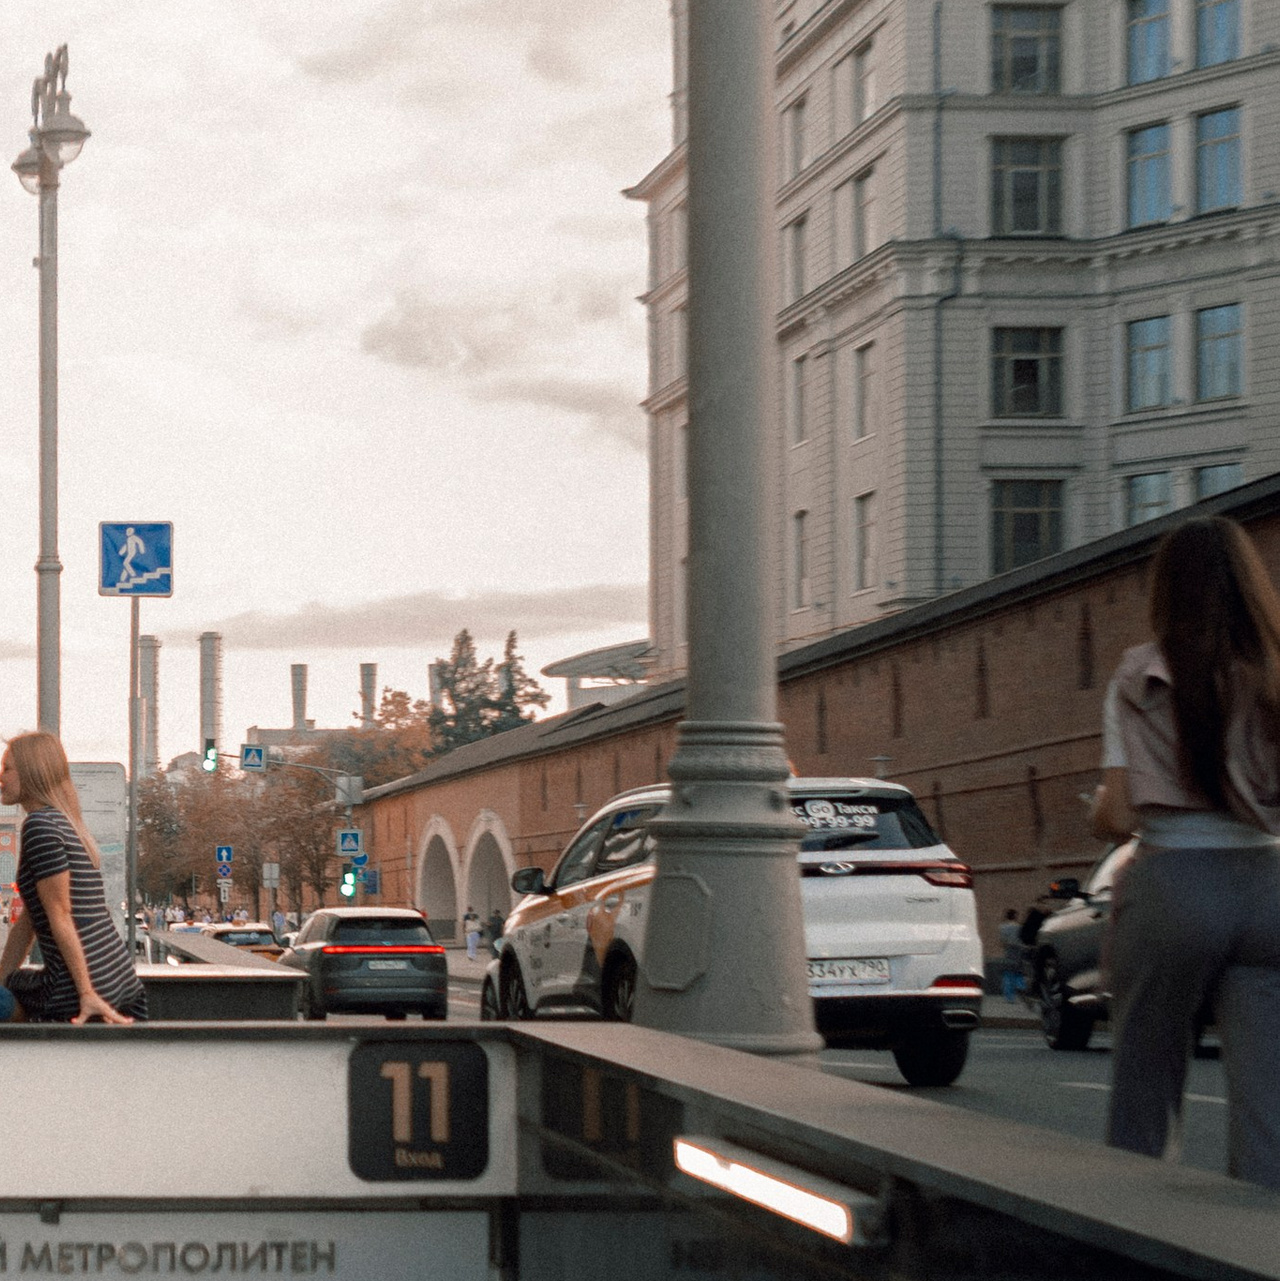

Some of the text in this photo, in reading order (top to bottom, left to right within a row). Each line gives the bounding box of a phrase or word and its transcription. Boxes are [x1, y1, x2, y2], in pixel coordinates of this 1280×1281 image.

[797, 815, 875, 828] 99-99-99
[380, 1060, 450, 1143] 11
[20, 1240, 336, 1274] МЕТРОПОЛИТЕН
